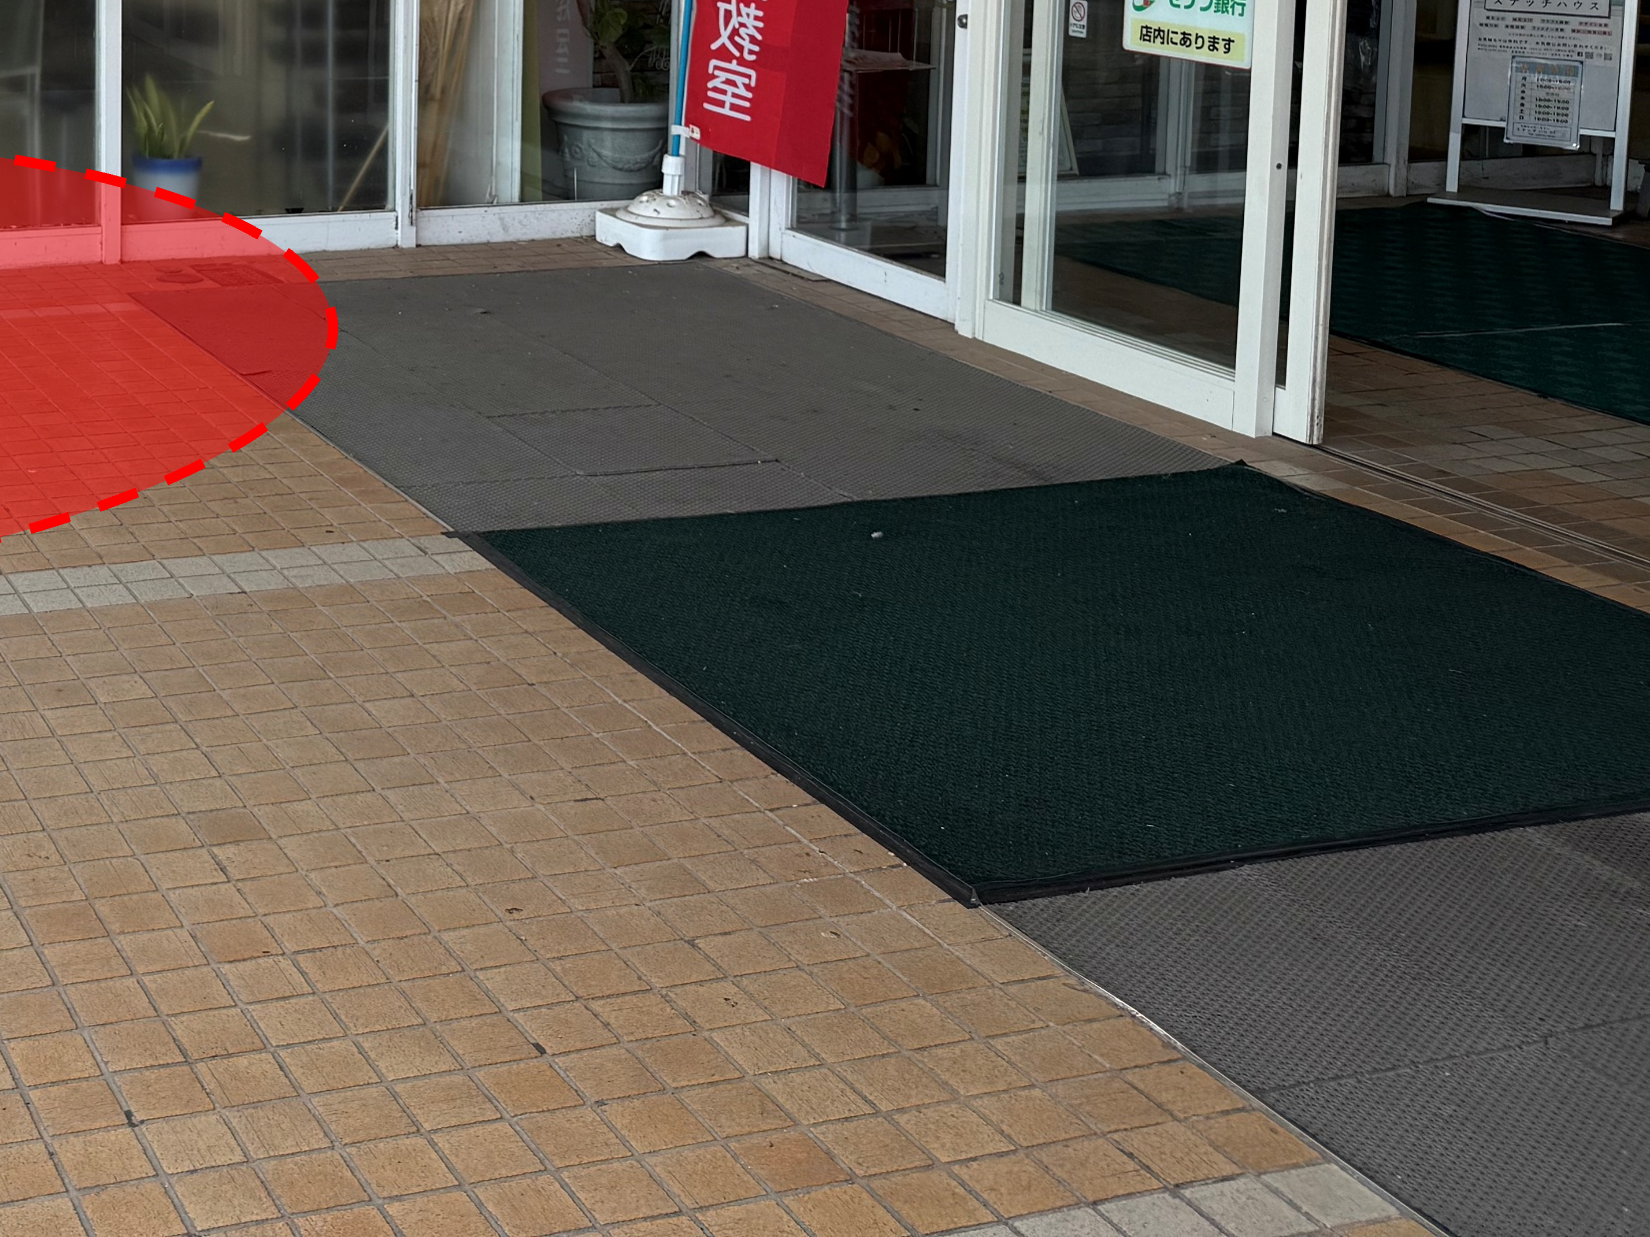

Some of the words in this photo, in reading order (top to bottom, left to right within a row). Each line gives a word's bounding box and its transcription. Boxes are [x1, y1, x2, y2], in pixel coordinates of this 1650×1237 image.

[1139, 24, 1235, 54] 店内にあります
